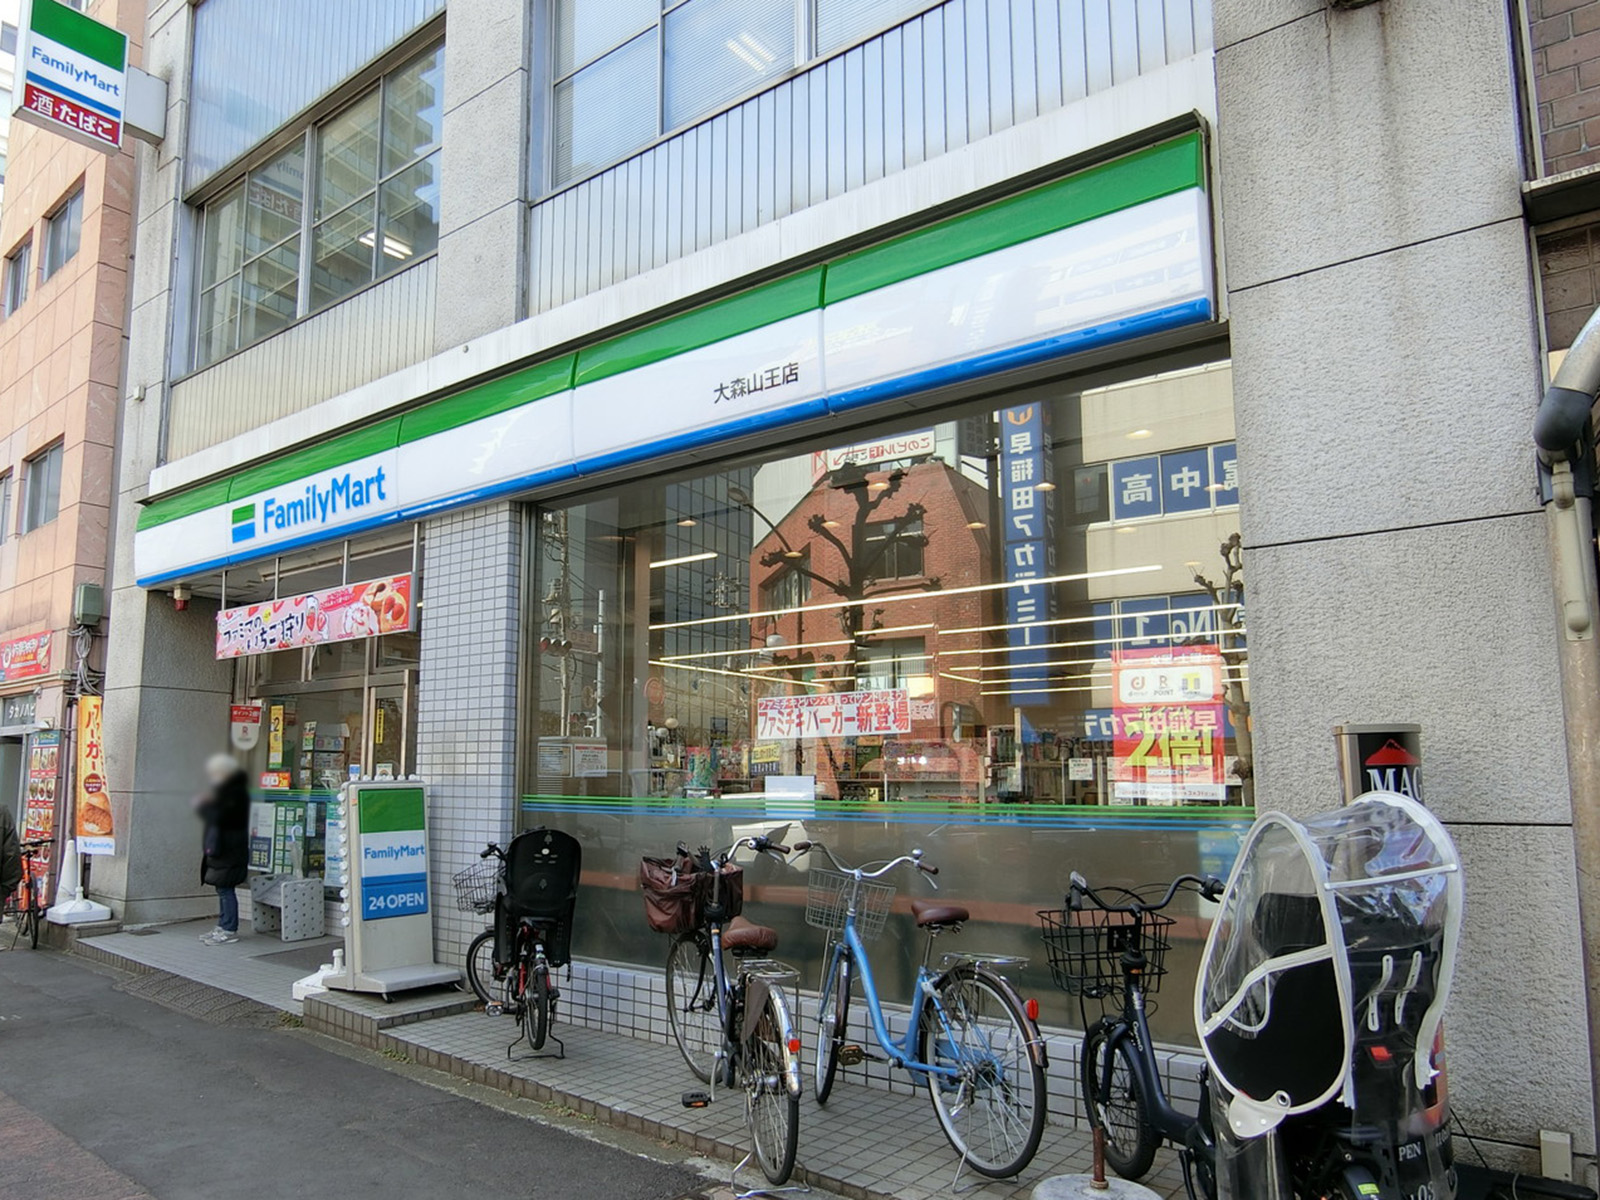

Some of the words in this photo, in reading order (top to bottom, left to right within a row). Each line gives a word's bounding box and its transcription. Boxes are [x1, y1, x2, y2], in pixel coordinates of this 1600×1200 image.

[32, 46, 119, 97] FamilyMart
[31, 90, 113, 141] 酒・たばこ
[714, 362, 799, 404] 大森山王店
[263, 466, 386, 533] FamilyMart
[758, 701, 910, 737] ファミチキバーガー新登場
[364, 844, 425, 861] FamilyMart
[1398, 1142, 1421, 1161] PEN
